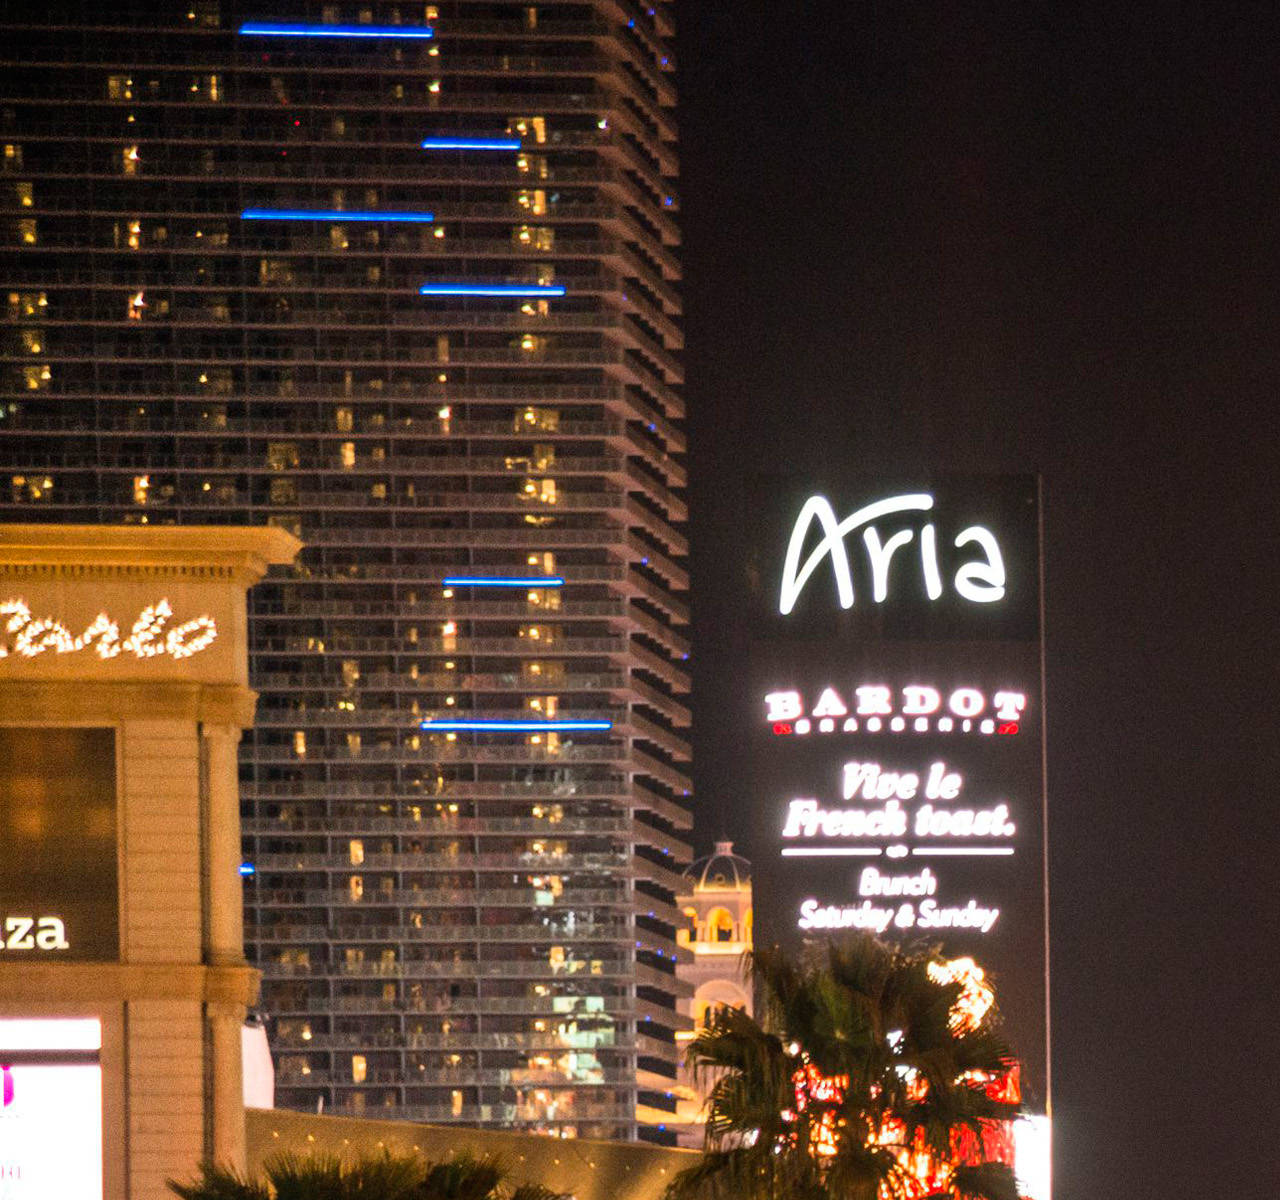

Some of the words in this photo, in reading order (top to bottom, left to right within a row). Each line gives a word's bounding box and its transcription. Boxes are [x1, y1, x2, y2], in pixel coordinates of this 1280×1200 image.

[779, 494, 1006, 616] Aria
[764, 685, 1026, 721] BARDOT
[925, 762, 962, 800] le
[782, 799, 907, 837] French
[859, 866, 937, 896] Brunch
[798, 899, 894, 933] Saturday
[894, 903, 915, 927] &
[916, 899, 999, 933] Sunday
